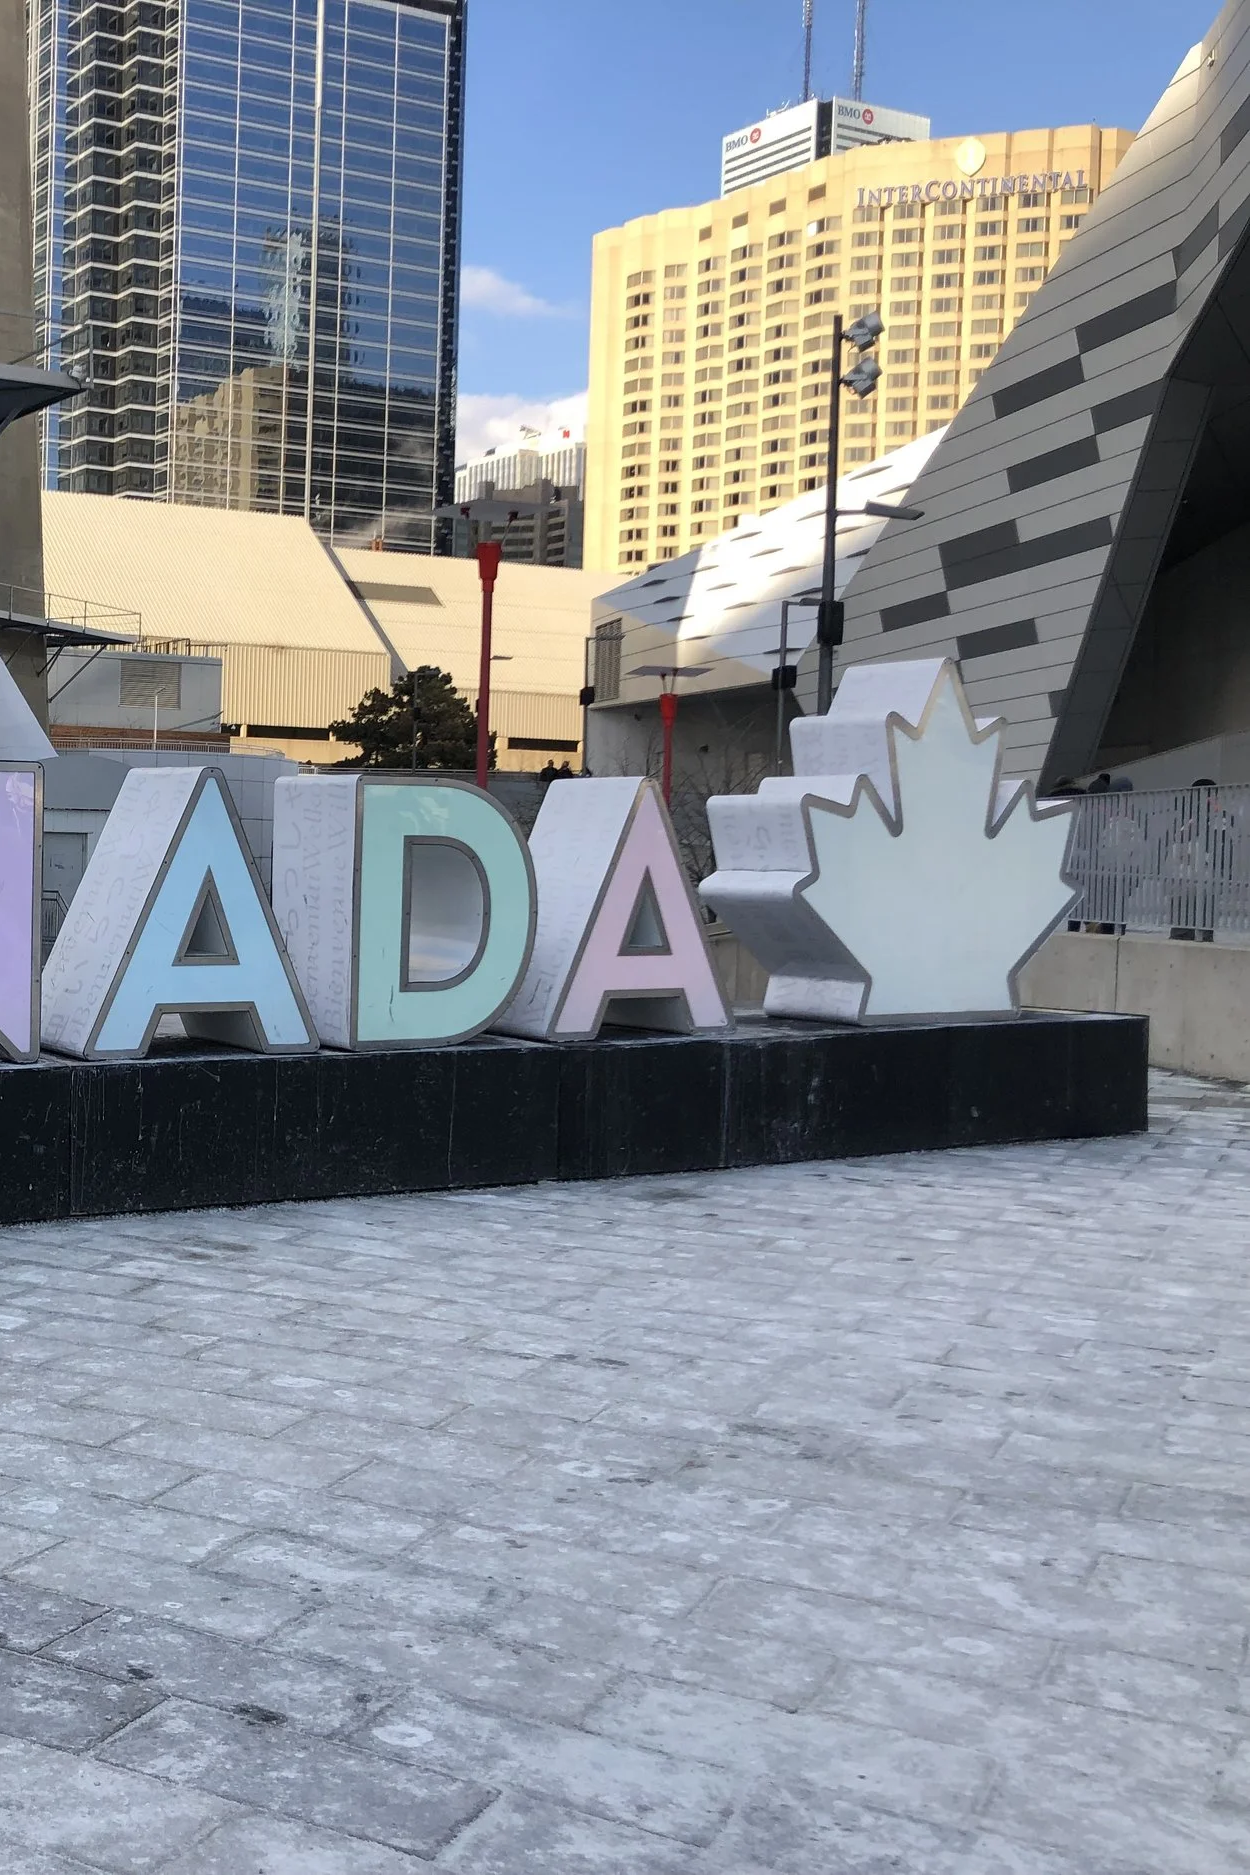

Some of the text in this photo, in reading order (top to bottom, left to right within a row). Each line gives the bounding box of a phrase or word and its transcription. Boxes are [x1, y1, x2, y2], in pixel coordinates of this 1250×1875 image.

[837, 104, 861, 120] BMO
[725, 134, 748, 153] BMO
[857, 169, 1088, 208] INTERCONTINENTAL
